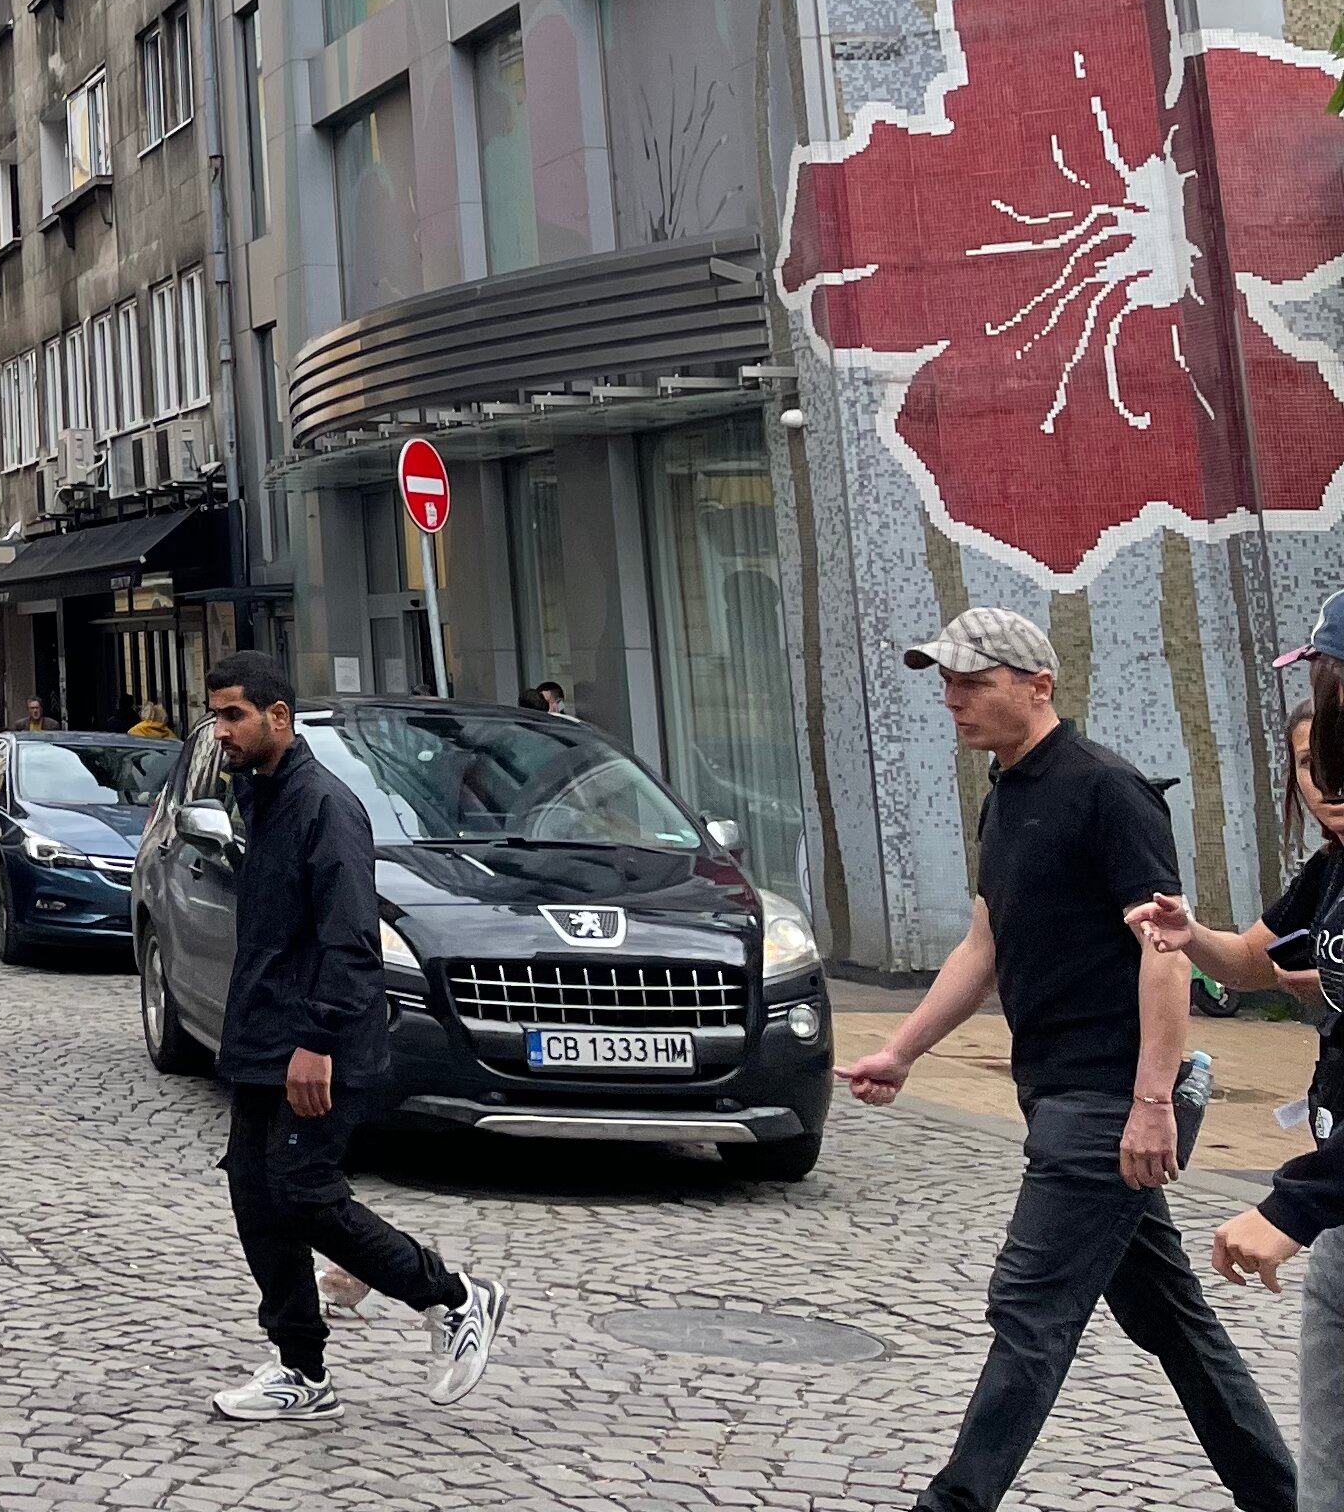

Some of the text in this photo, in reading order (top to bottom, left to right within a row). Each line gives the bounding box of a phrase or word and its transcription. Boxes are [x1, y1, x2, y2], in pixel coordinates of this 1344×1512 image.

[547, 1036, 580, 1061] CB
[588, 1037, 648, 1062] 1333
[653, 1038, 687, 1063] HM
